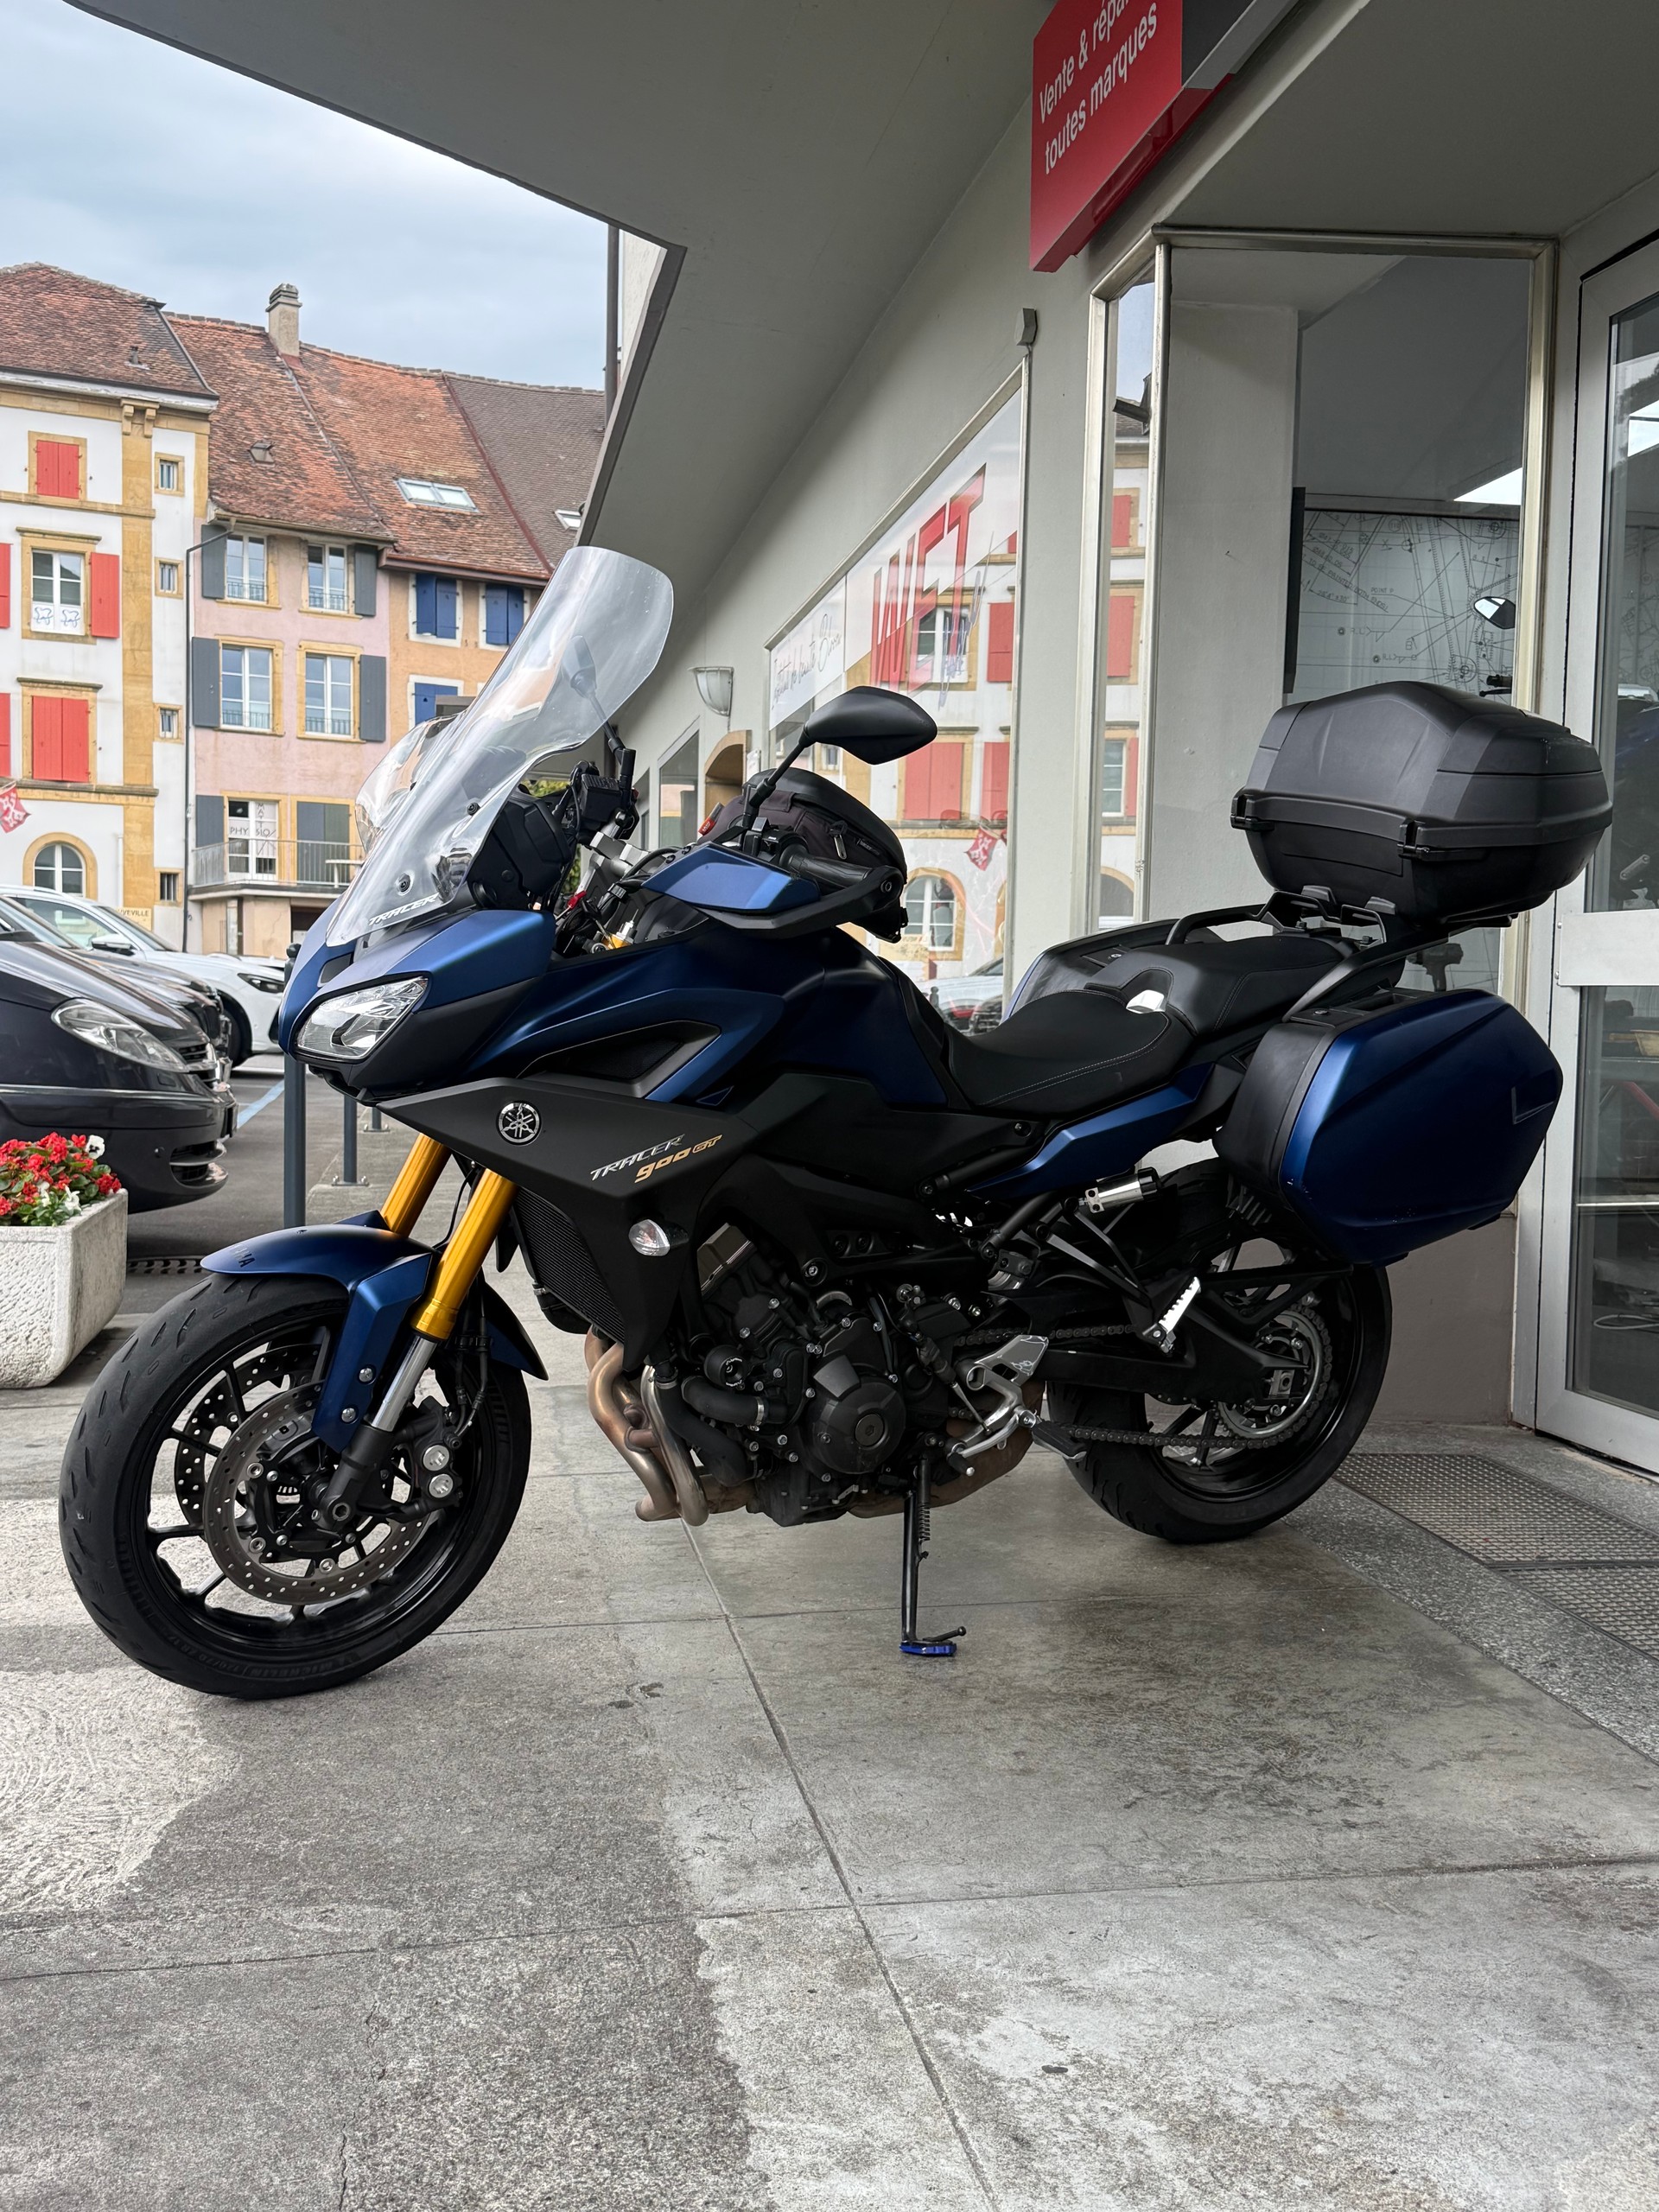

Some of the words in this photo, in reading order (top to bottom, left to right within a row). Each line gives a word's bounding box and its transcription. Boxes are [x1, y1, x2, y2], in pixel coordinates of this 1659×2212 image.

[1039, 55, 1075, 124] Vente
[1078, 29, 1089, 70] &
[1093, 0, 1128, 51] répa
[1046, 99, 1086, 175] toutes
[1090, 2, 1157, 117] marques
[368, 892, 440, 926] TRACER
[590, 1133, 685, 1181] TRACER
[634, 1147, 691, 1184] 900
[692, 1134, 723, 1154] GT
